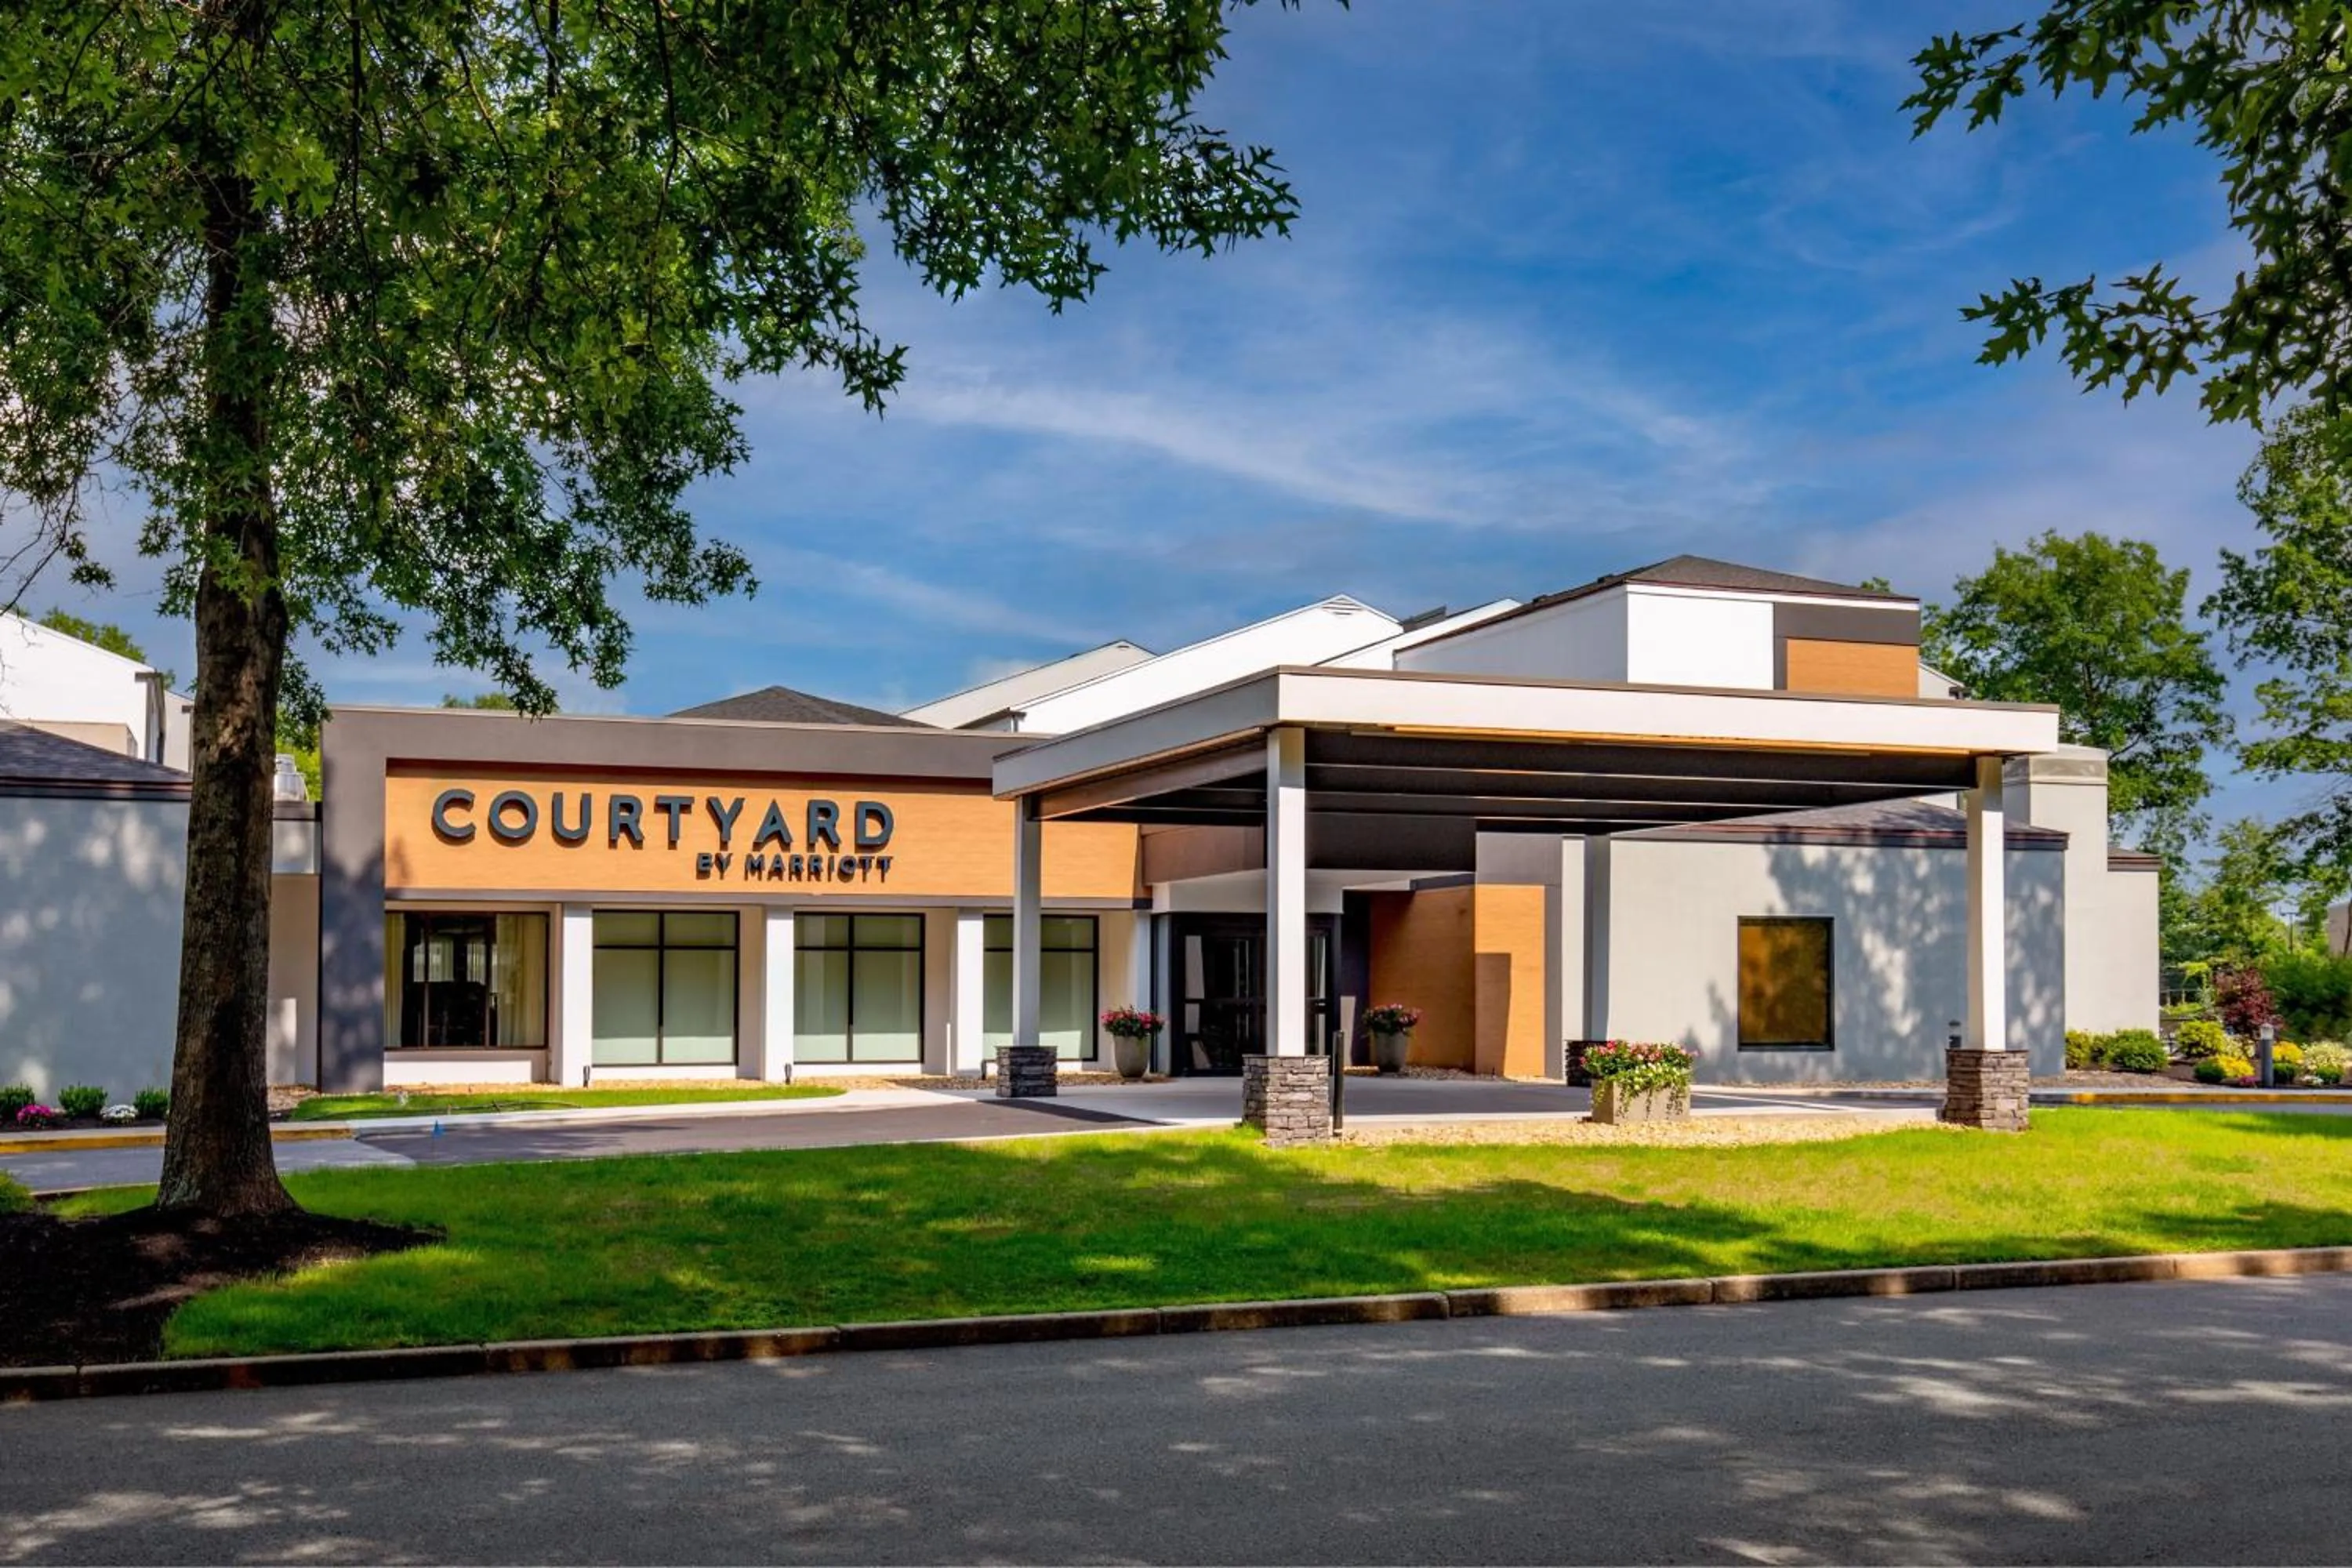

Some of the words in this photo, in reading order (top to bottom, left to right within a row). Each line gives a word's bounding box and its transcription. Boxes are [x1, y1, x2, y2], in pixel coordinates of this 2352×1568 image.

[431, 789, 895, 848] COURTYARD
[695, 852, 732, 877] BY
[744, 853, 893, 880] MARRIOTT
